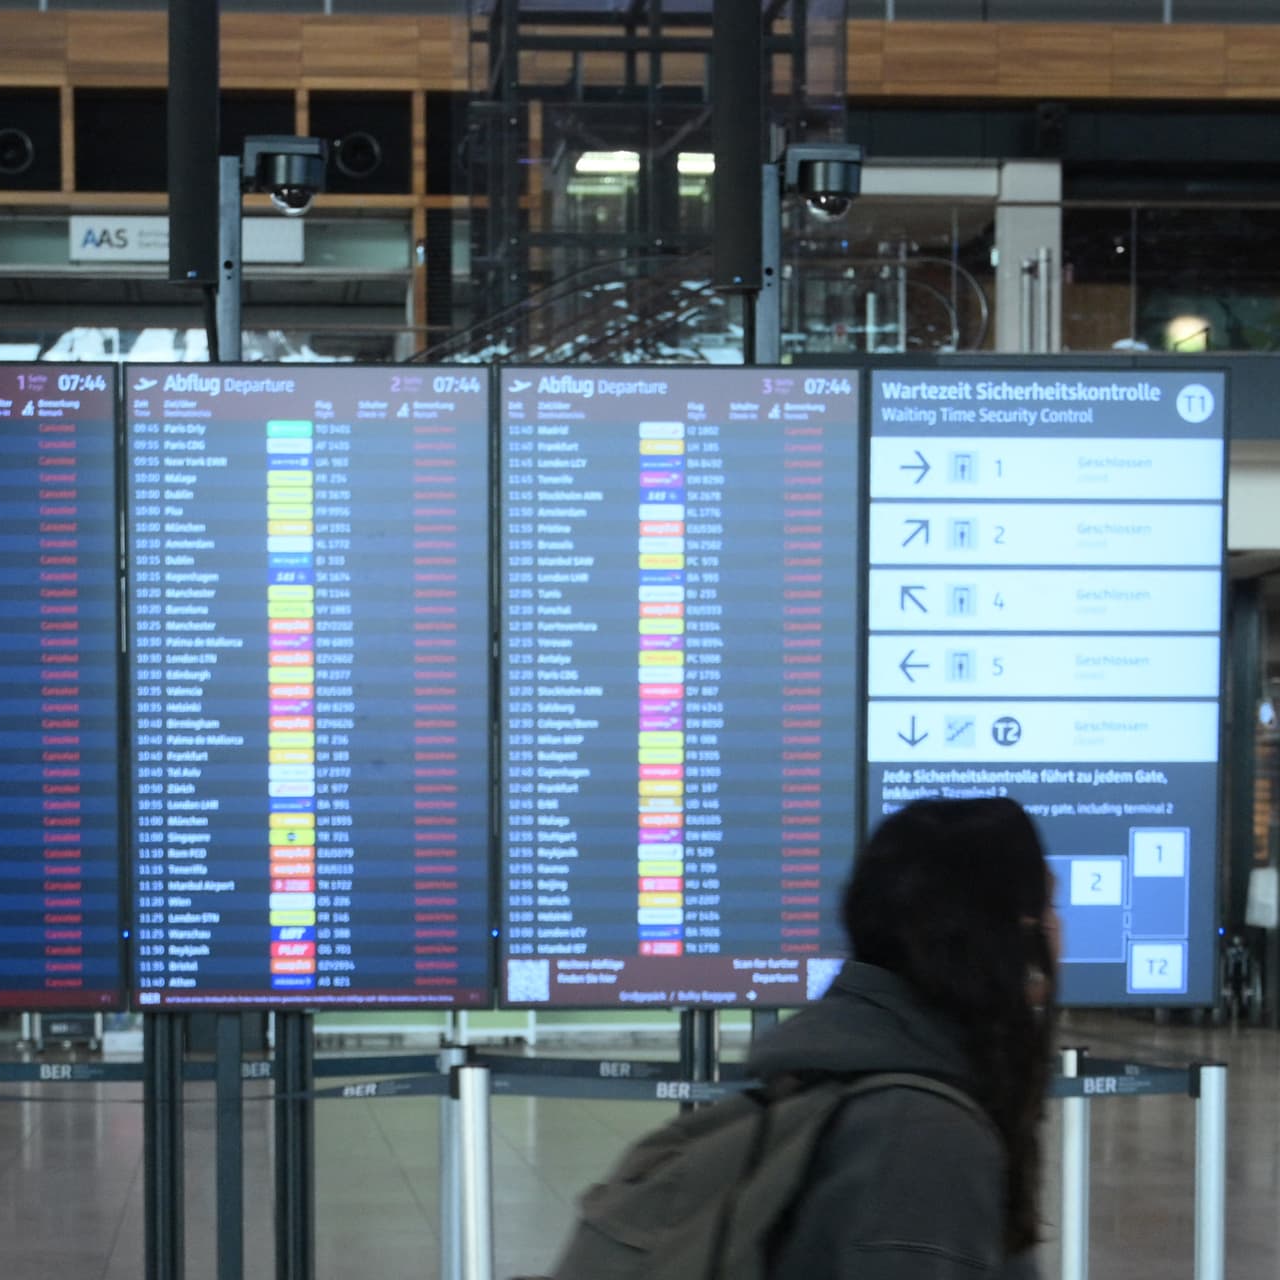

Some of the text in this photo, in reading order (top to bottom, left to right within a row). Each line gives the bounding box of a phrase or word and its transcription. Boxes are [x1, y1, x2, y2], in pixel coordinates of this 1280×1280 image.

[82, 228, 128, 248] AAS
[17, 375, 25, 390] 1
[57, 374, 107, 391] 07:44
[164, 374, 295, 396] Abflug Departure
[390, 376, 401, 391] 2
[433, 376, 481, 392] 07:44
[538, 376, 668, 397] Abflug Departure
[762, 379, 773, 394] 3
[804, 379, 852, 395] 07:44
[882, 382, 1162, 402] Wartezeit Sicherheitskontrolle
[1182, 395, 1208, 412] T1
[882, 408, 1094, 426] Waiting Time Security Control
[995, 459, 1002, 477] 1
[994, 527, 1005, 544] 2
[994, 594, 1005, 610] 4
[992, 658, 1004, 675] 5
[882, 769, 1168, 786] Jede Sicherheitskontrolle führt zu jedem Gate,
[1077, 803, 1123, 816] including
[1124, 803, 1165, 815] terminal
[1166, 803, 1174, 814] 2
[1155, 846, 1163, 863] 1
[1091, 875, 1102, 891] 2
[1146, 960, 1168, 975] T2
[40, 1064, 72, 1079] BER
[241, 1062, 271, 1077] BER
[600, 1062, 631, 1076] BER
[343, 1083, 377, 1096] BER
[656, 1082, 690, 1098] BER
[1083, 1077, 1117, 1094] BER
